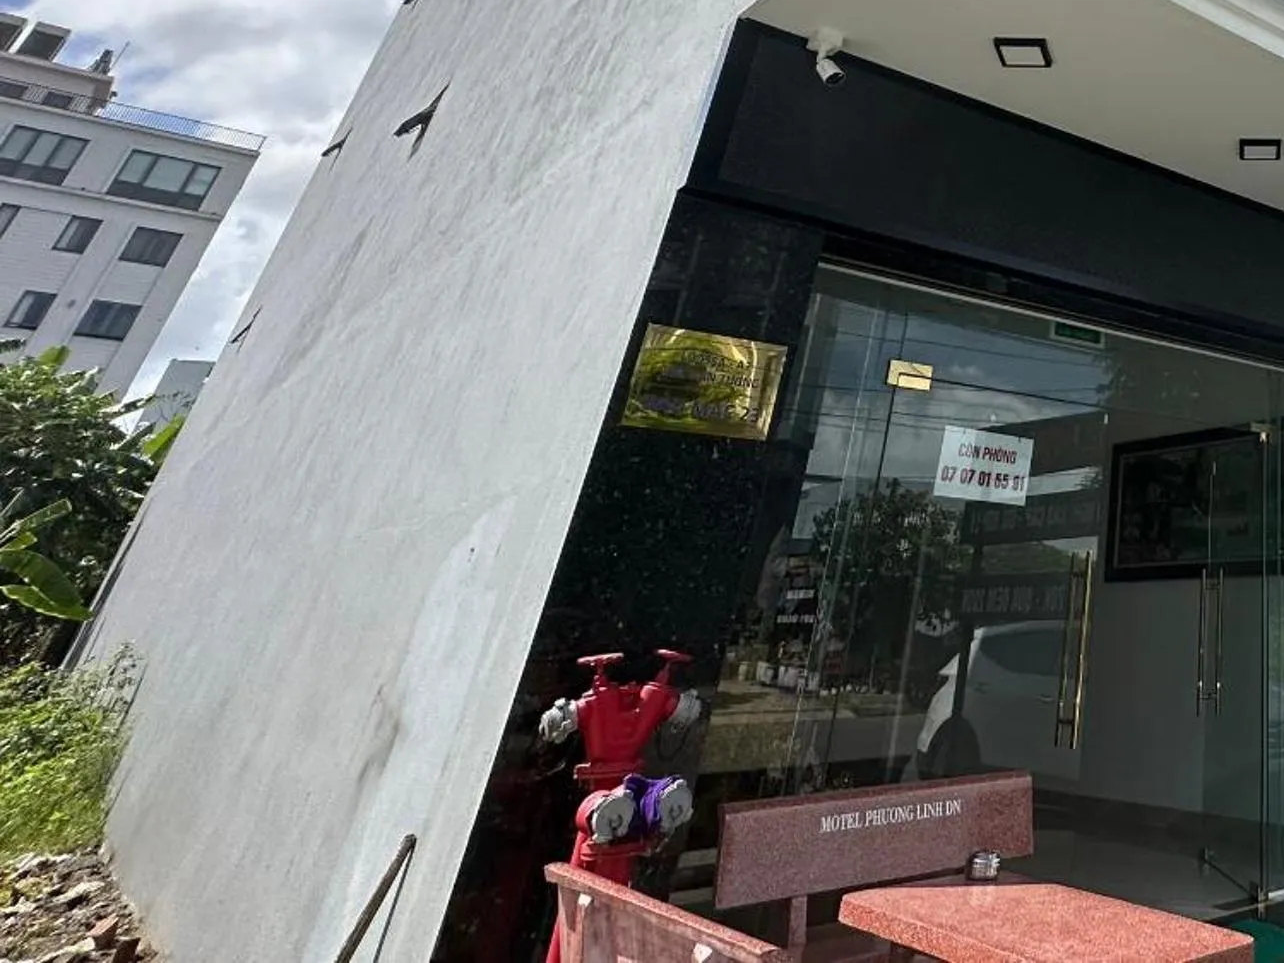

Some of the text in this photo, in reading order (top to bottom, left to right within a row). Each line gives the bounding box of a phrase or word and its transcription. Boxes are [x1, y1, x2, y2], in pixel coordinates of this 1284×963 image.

[960, 468, 976, 485] 07
[819, 811, 864, 834] MOTEL
[917, 801, 943, 820] LINH
[946, 798, 962, 816] DN
